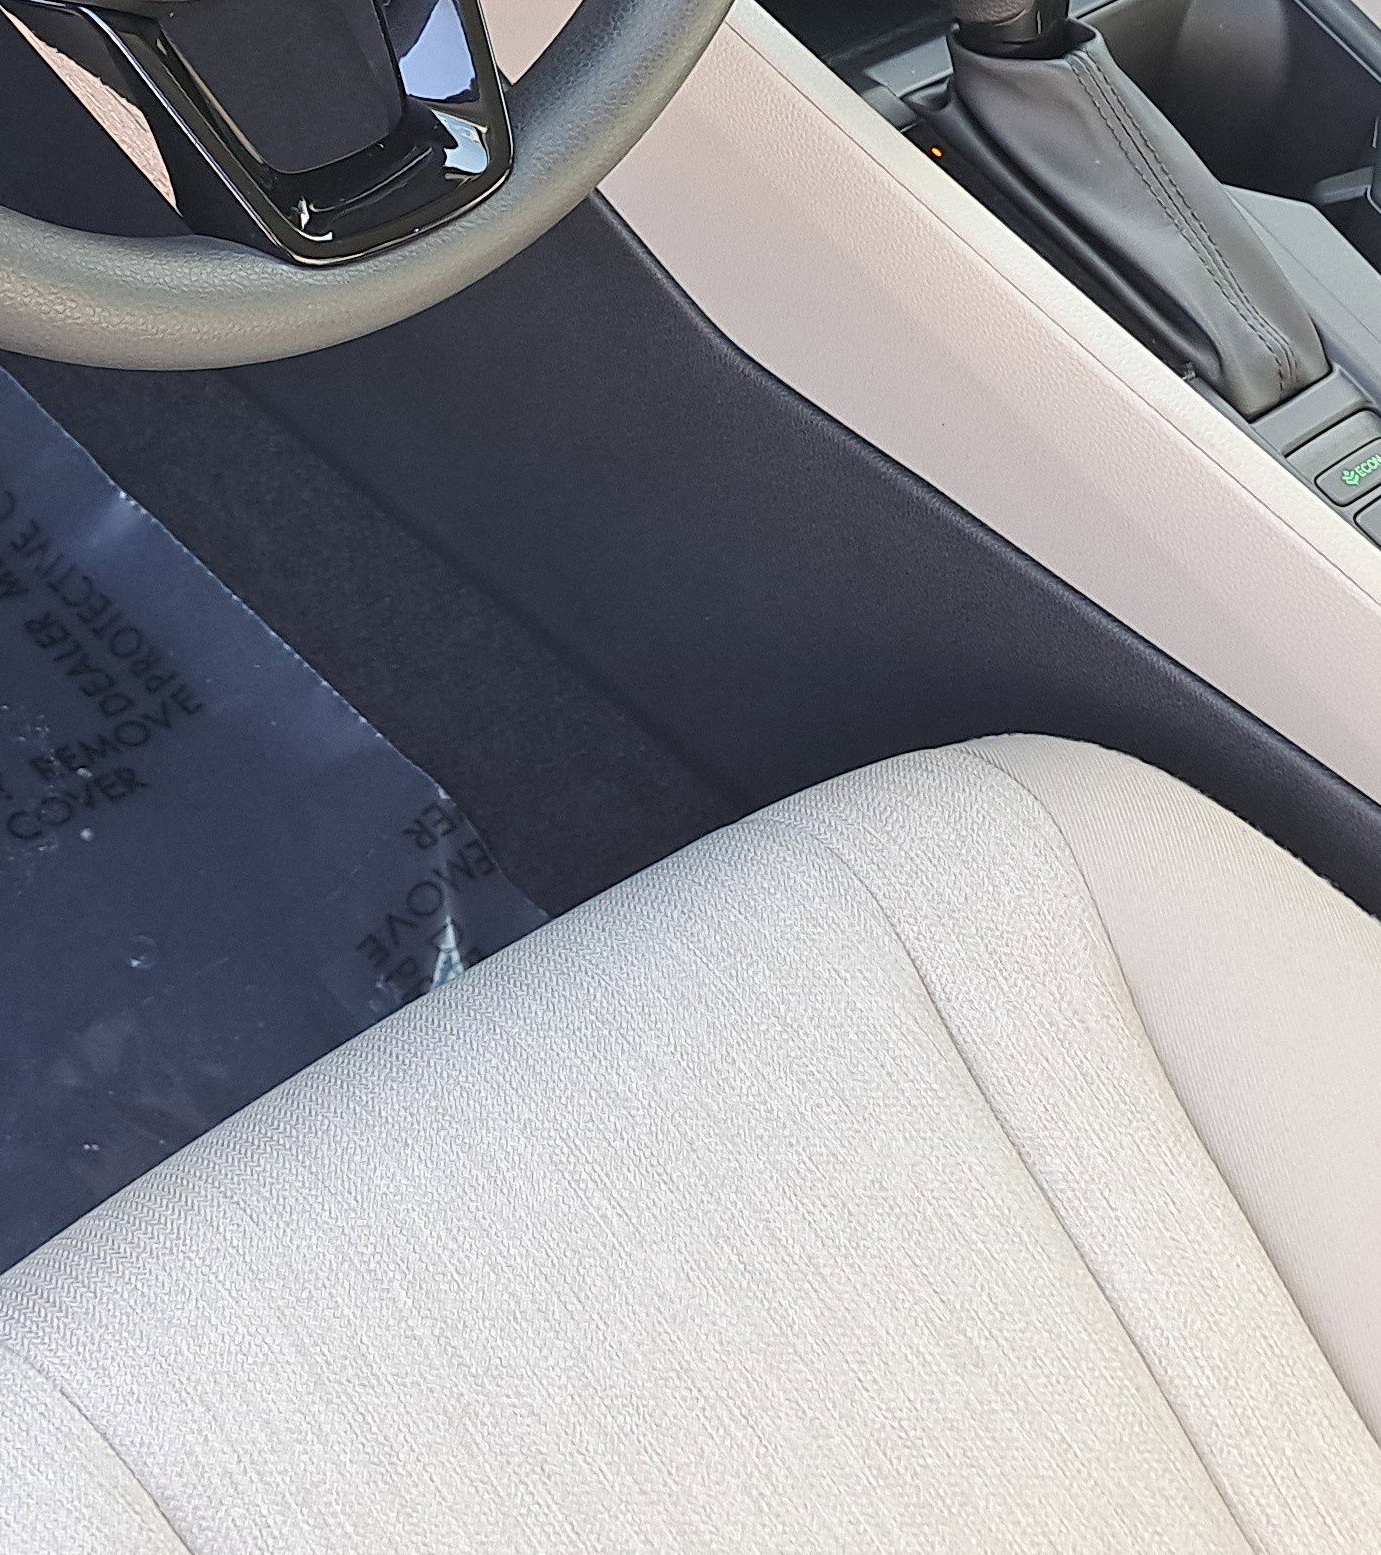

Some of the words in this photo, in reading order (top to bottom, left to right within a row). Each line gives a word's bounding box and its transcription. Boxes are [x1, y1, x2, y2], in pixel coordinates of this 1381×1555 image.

[8, 517, 180, 696] PROTECTIVE
[22, 610, 137, 719] DEALER
[28, 681, 208, 782] REMOVE
[4, 765, 152, 842] COVER
